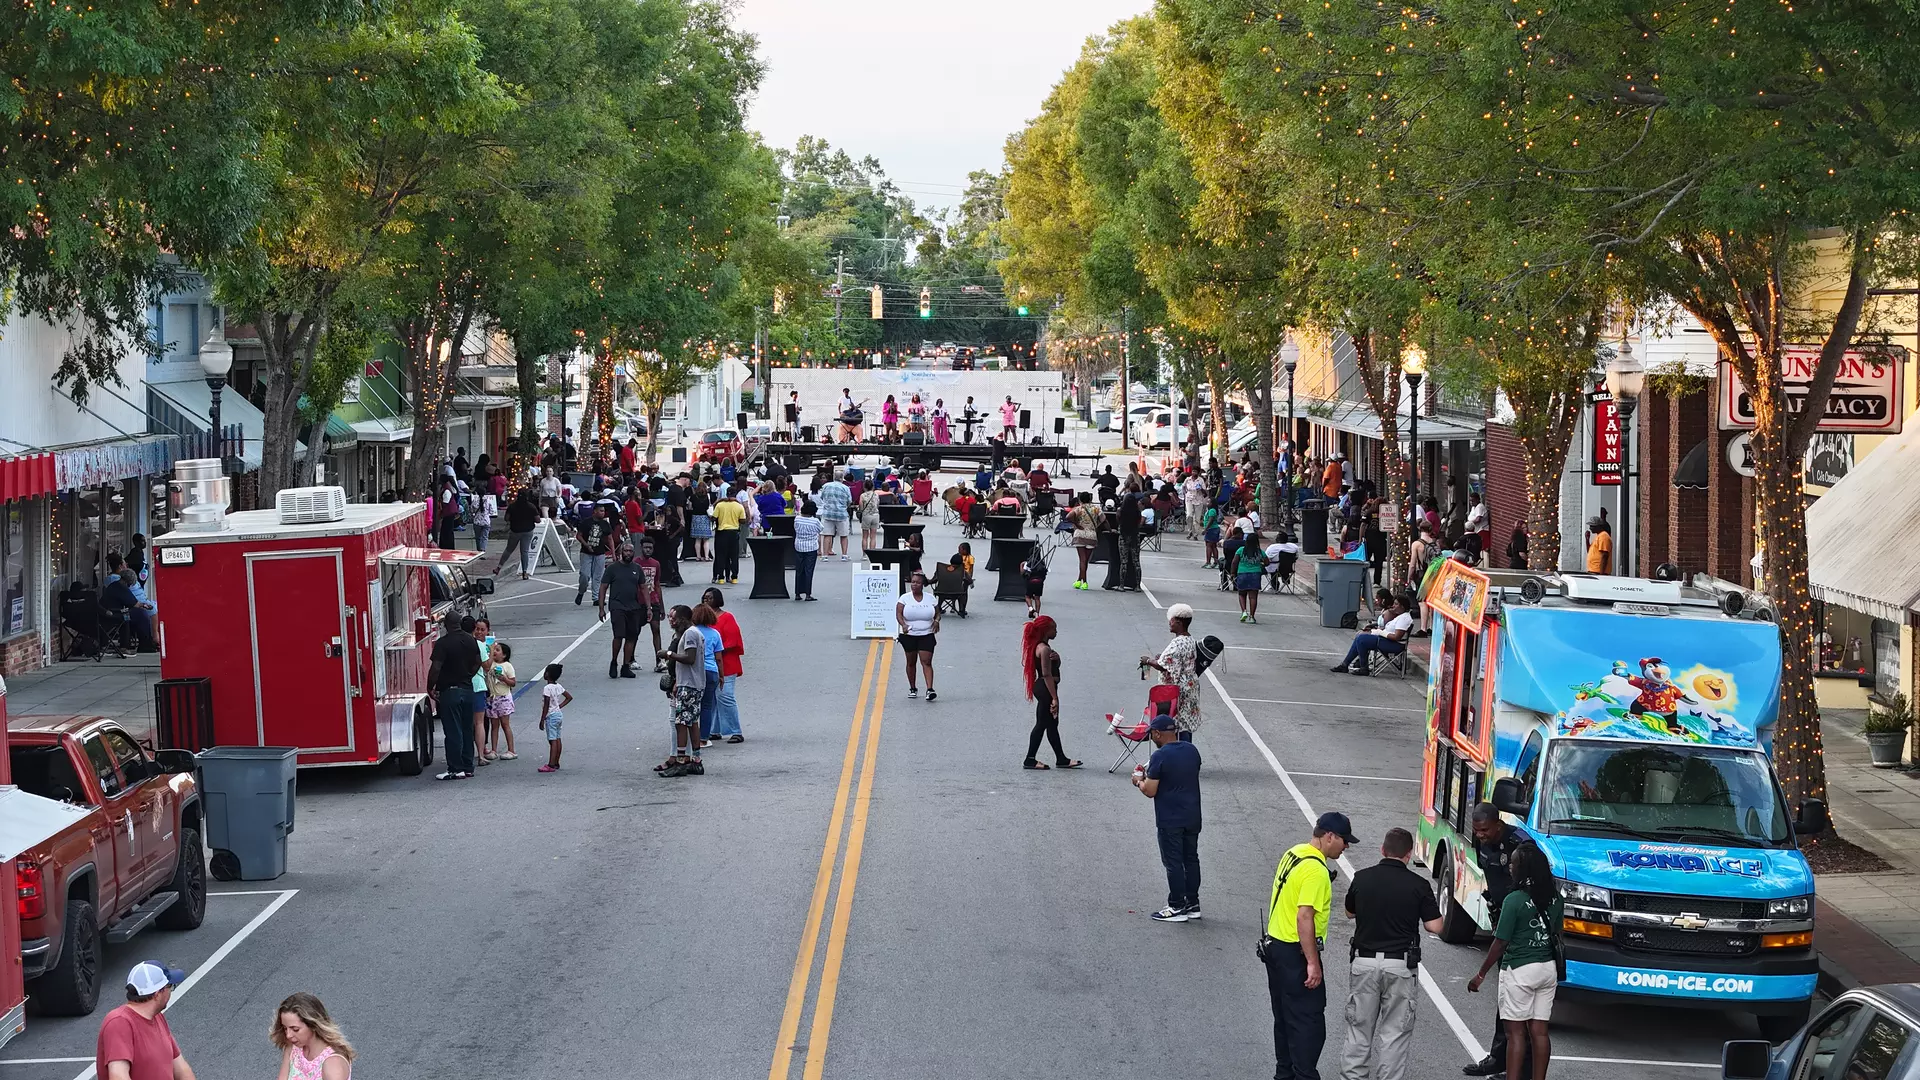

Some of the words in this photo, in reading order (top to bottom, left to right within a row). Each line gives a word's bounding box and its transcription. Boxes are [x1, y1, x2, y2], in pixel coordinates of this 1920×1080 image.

[1604, 405, 1618, 460] PAWN
[1597, 463, 1621, 472] SHO
[1639, 844, 1685, 852] Tropical
[1684, 846, 1728, 856] Shaved
[1606, 850, 1709, 874] KONA
[1528, 939, 1549, 947] TENN
[1617, 971, 1754, 993] KONA-ICE.COM
